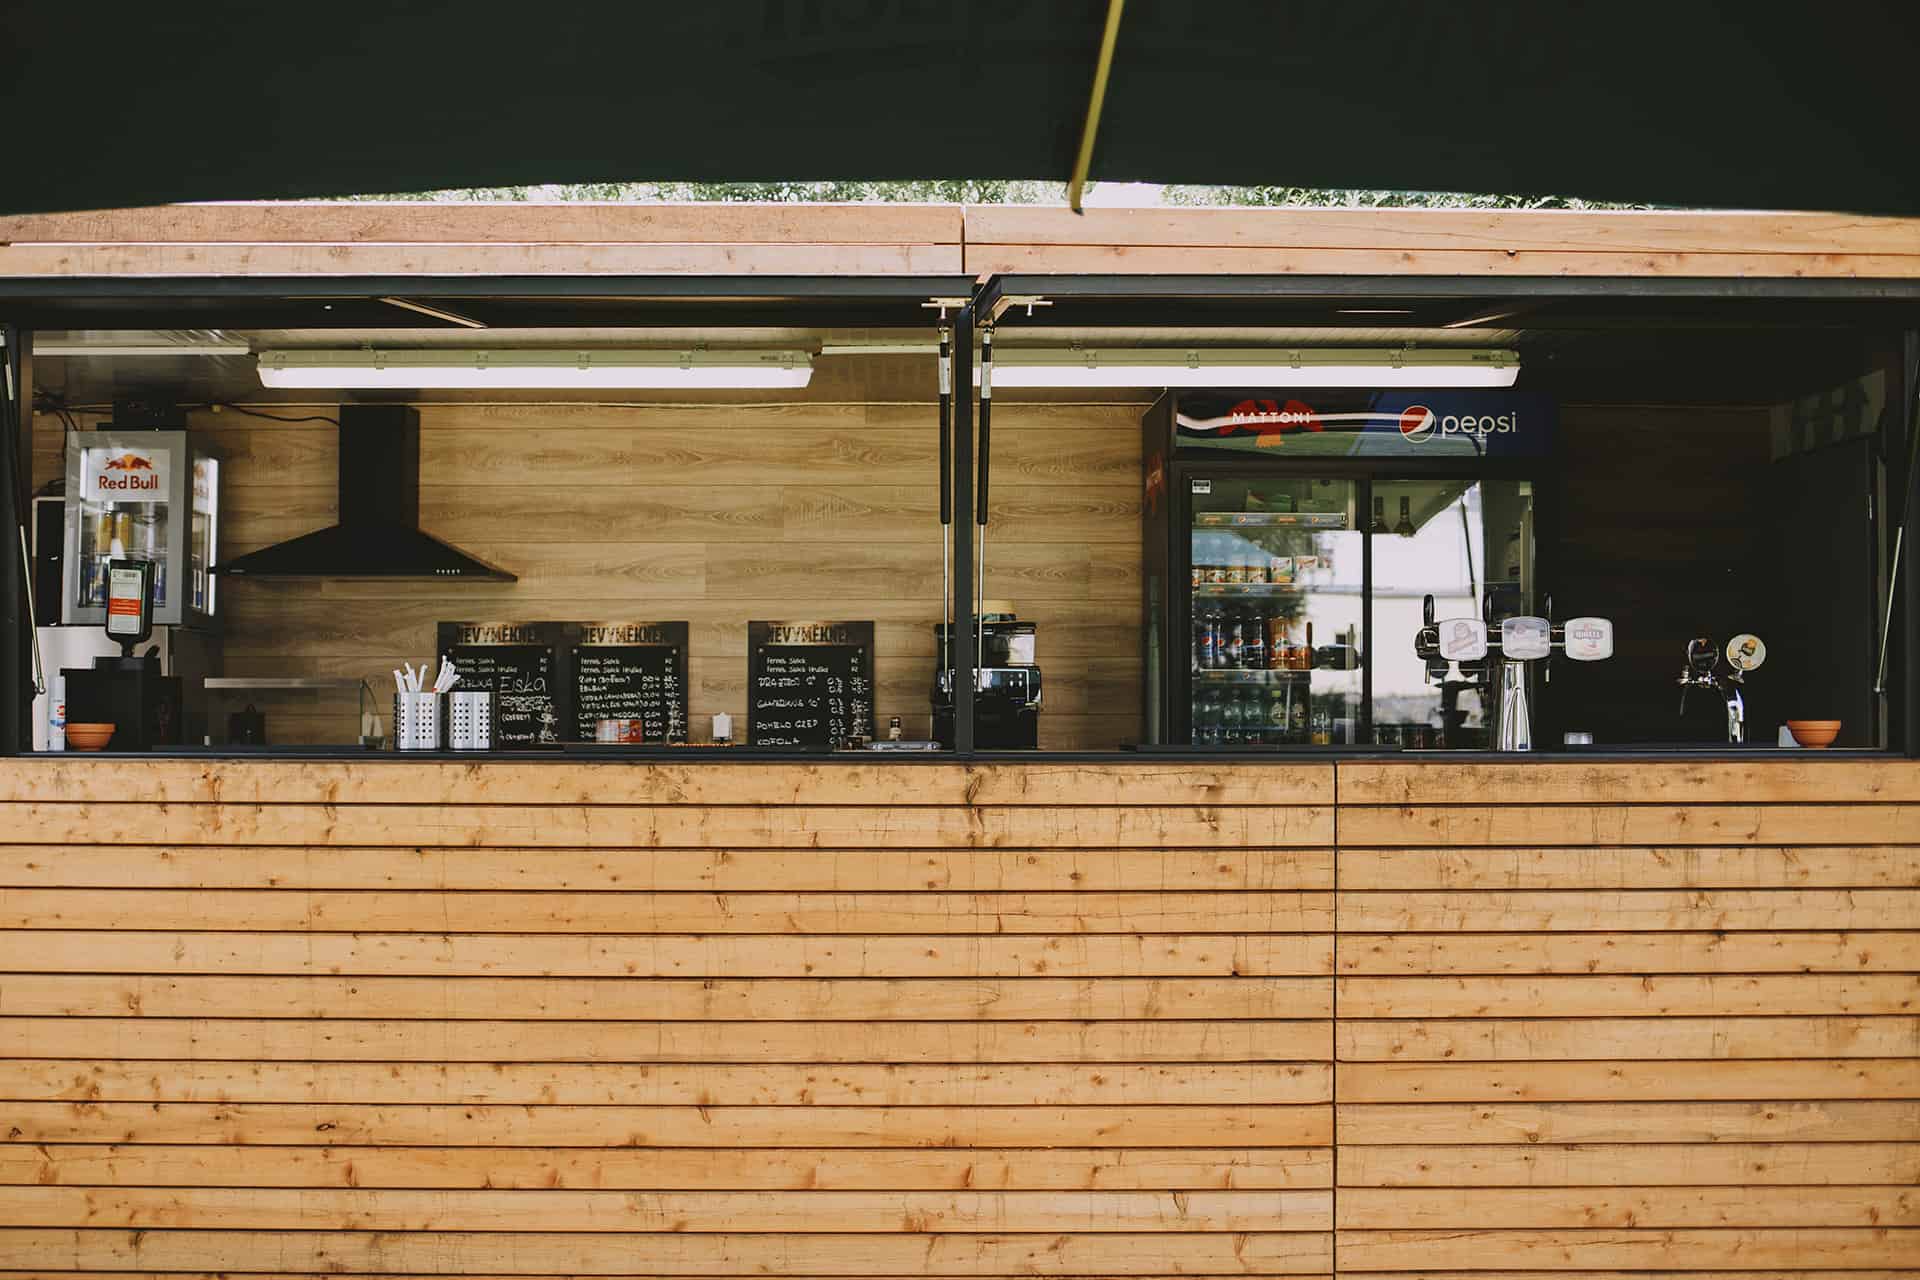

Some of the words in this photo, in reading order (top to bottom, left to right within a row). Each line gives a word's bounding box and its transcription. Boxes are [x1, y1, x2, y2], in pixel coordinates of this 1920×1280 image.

[1232, 411, 1312, 424] MATTONI
[1441, 411, 1517, 439] pepsi
[98, 474, 128, 490] Red
[130, 474, 158, 490] Bull
